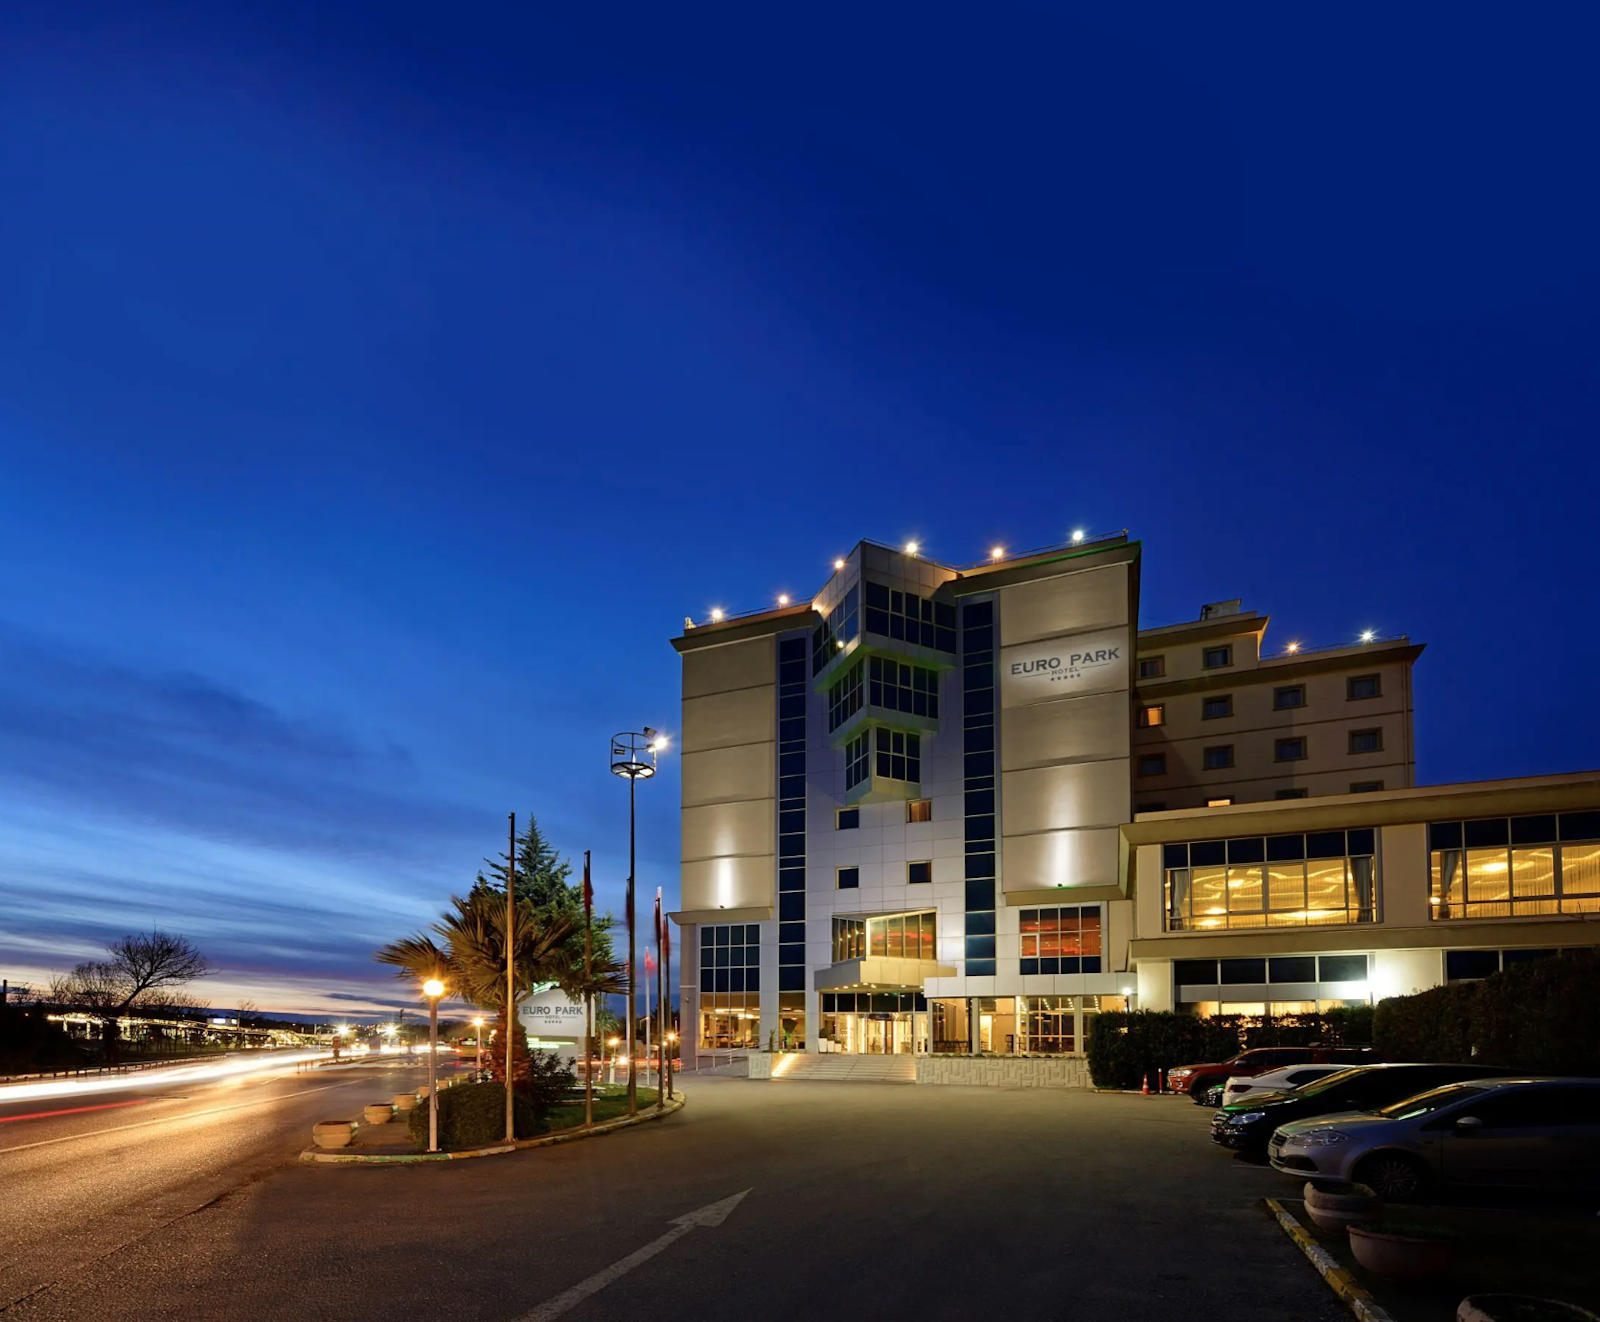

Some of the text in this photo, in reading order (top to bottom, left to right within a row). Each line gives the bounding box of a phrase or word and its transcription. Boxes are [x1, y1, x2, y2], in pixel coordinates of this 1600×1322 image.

[1011, 647, 1120, 675] EURO PARK
[1051, 667, 1079, 675] HOTEL
[522, 1006, 583, 1015] EURO PARK
